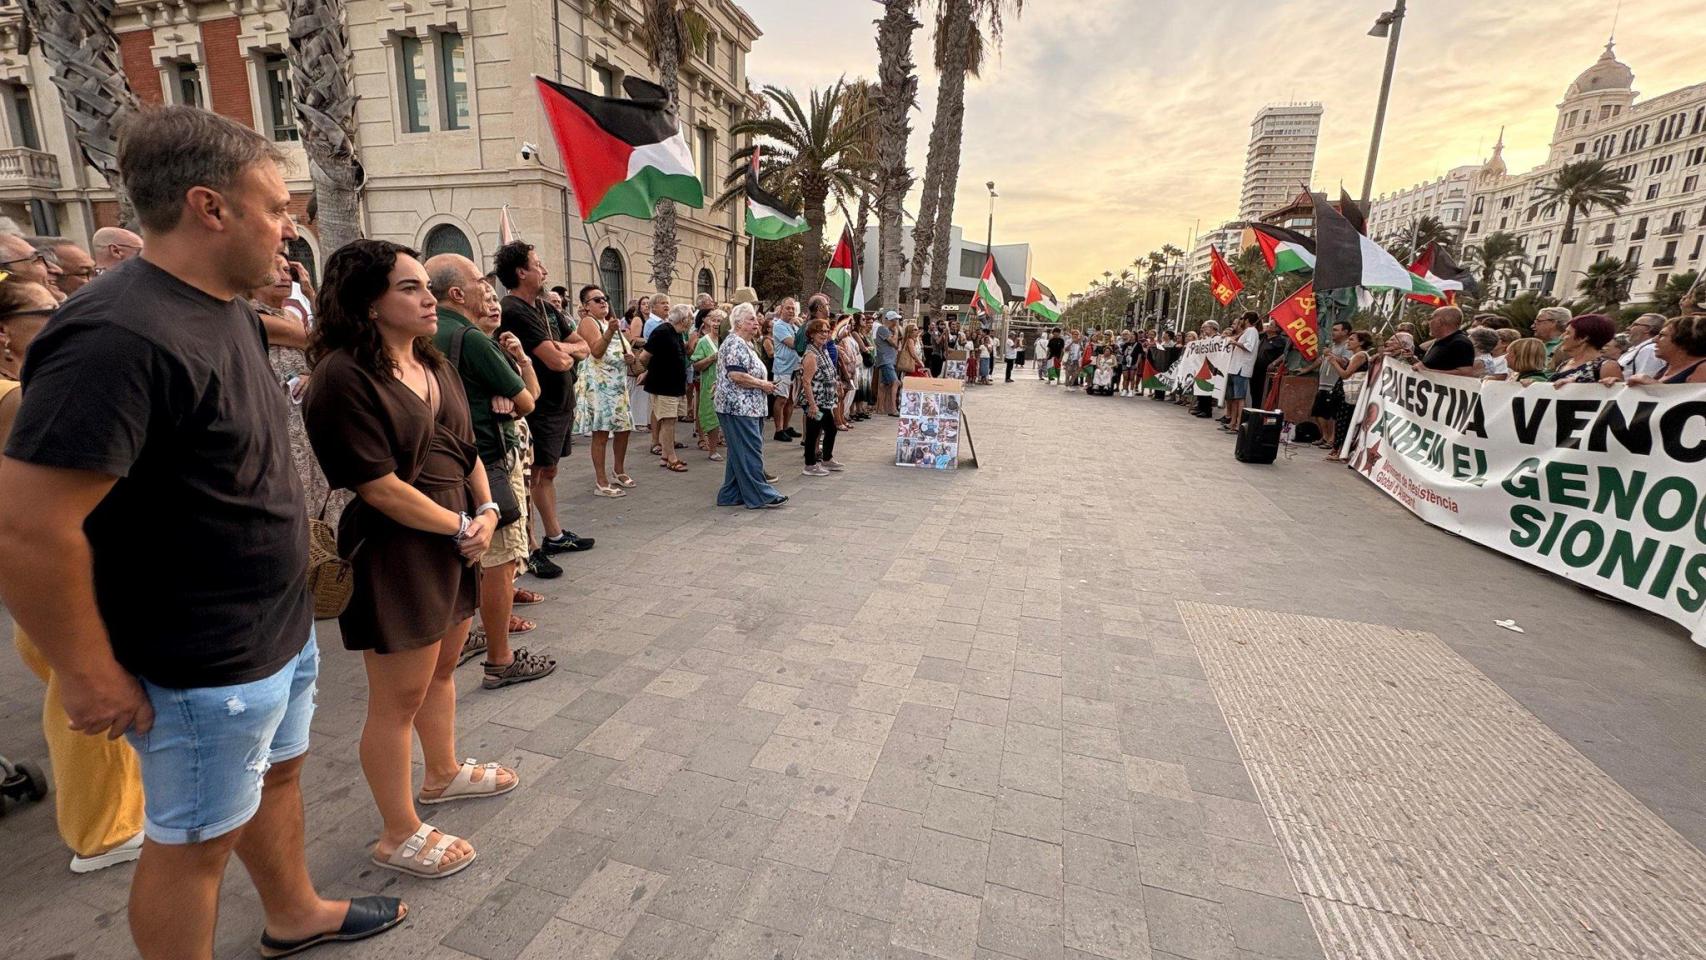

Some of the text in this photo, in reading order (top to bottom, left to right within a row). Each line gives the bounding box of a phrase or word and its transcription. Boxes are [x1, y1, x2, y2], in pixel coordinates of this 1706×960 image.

[1213, 284, 1233, 301] PE
[1287, 318, 1319, 356] PCPE
[1379, 366, 1706, 463] PALESTINA VENC
[1452, 442, 1489, 488] EL
[1501, 457, 1706, 548] GENO
[1509, 504, 1706, 613] SIONIS
